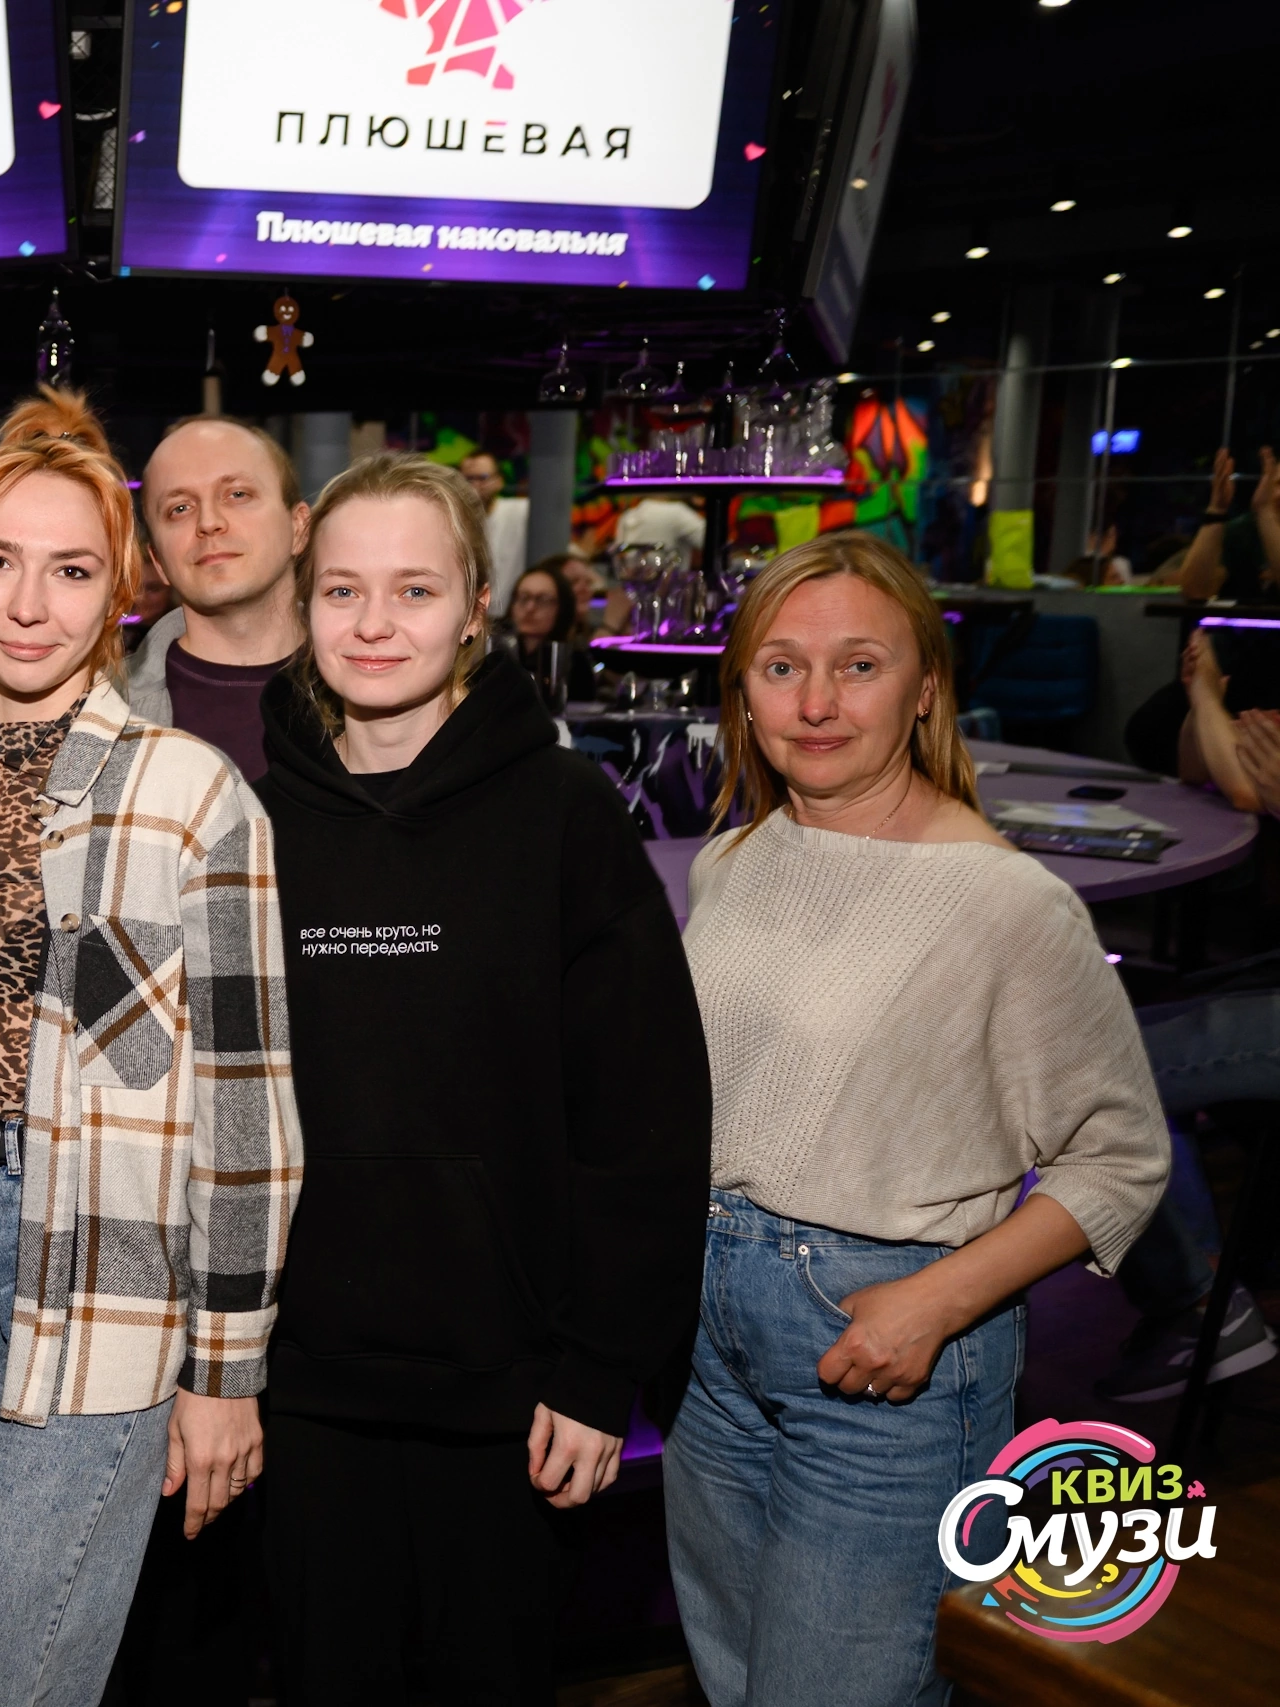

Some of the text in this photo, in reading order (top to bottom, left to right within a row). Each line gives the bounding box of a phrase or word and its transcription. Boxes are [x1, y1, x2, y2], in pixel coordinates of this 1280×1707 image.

[276, 110, 634, 161] ПЛЮШЕВАЯ
[255, 210, 629, 257] Плюшевая наковальня
[300, 923, 442, 941] все очень круто, но
[301, 940, 439, 958] нужно переделать
